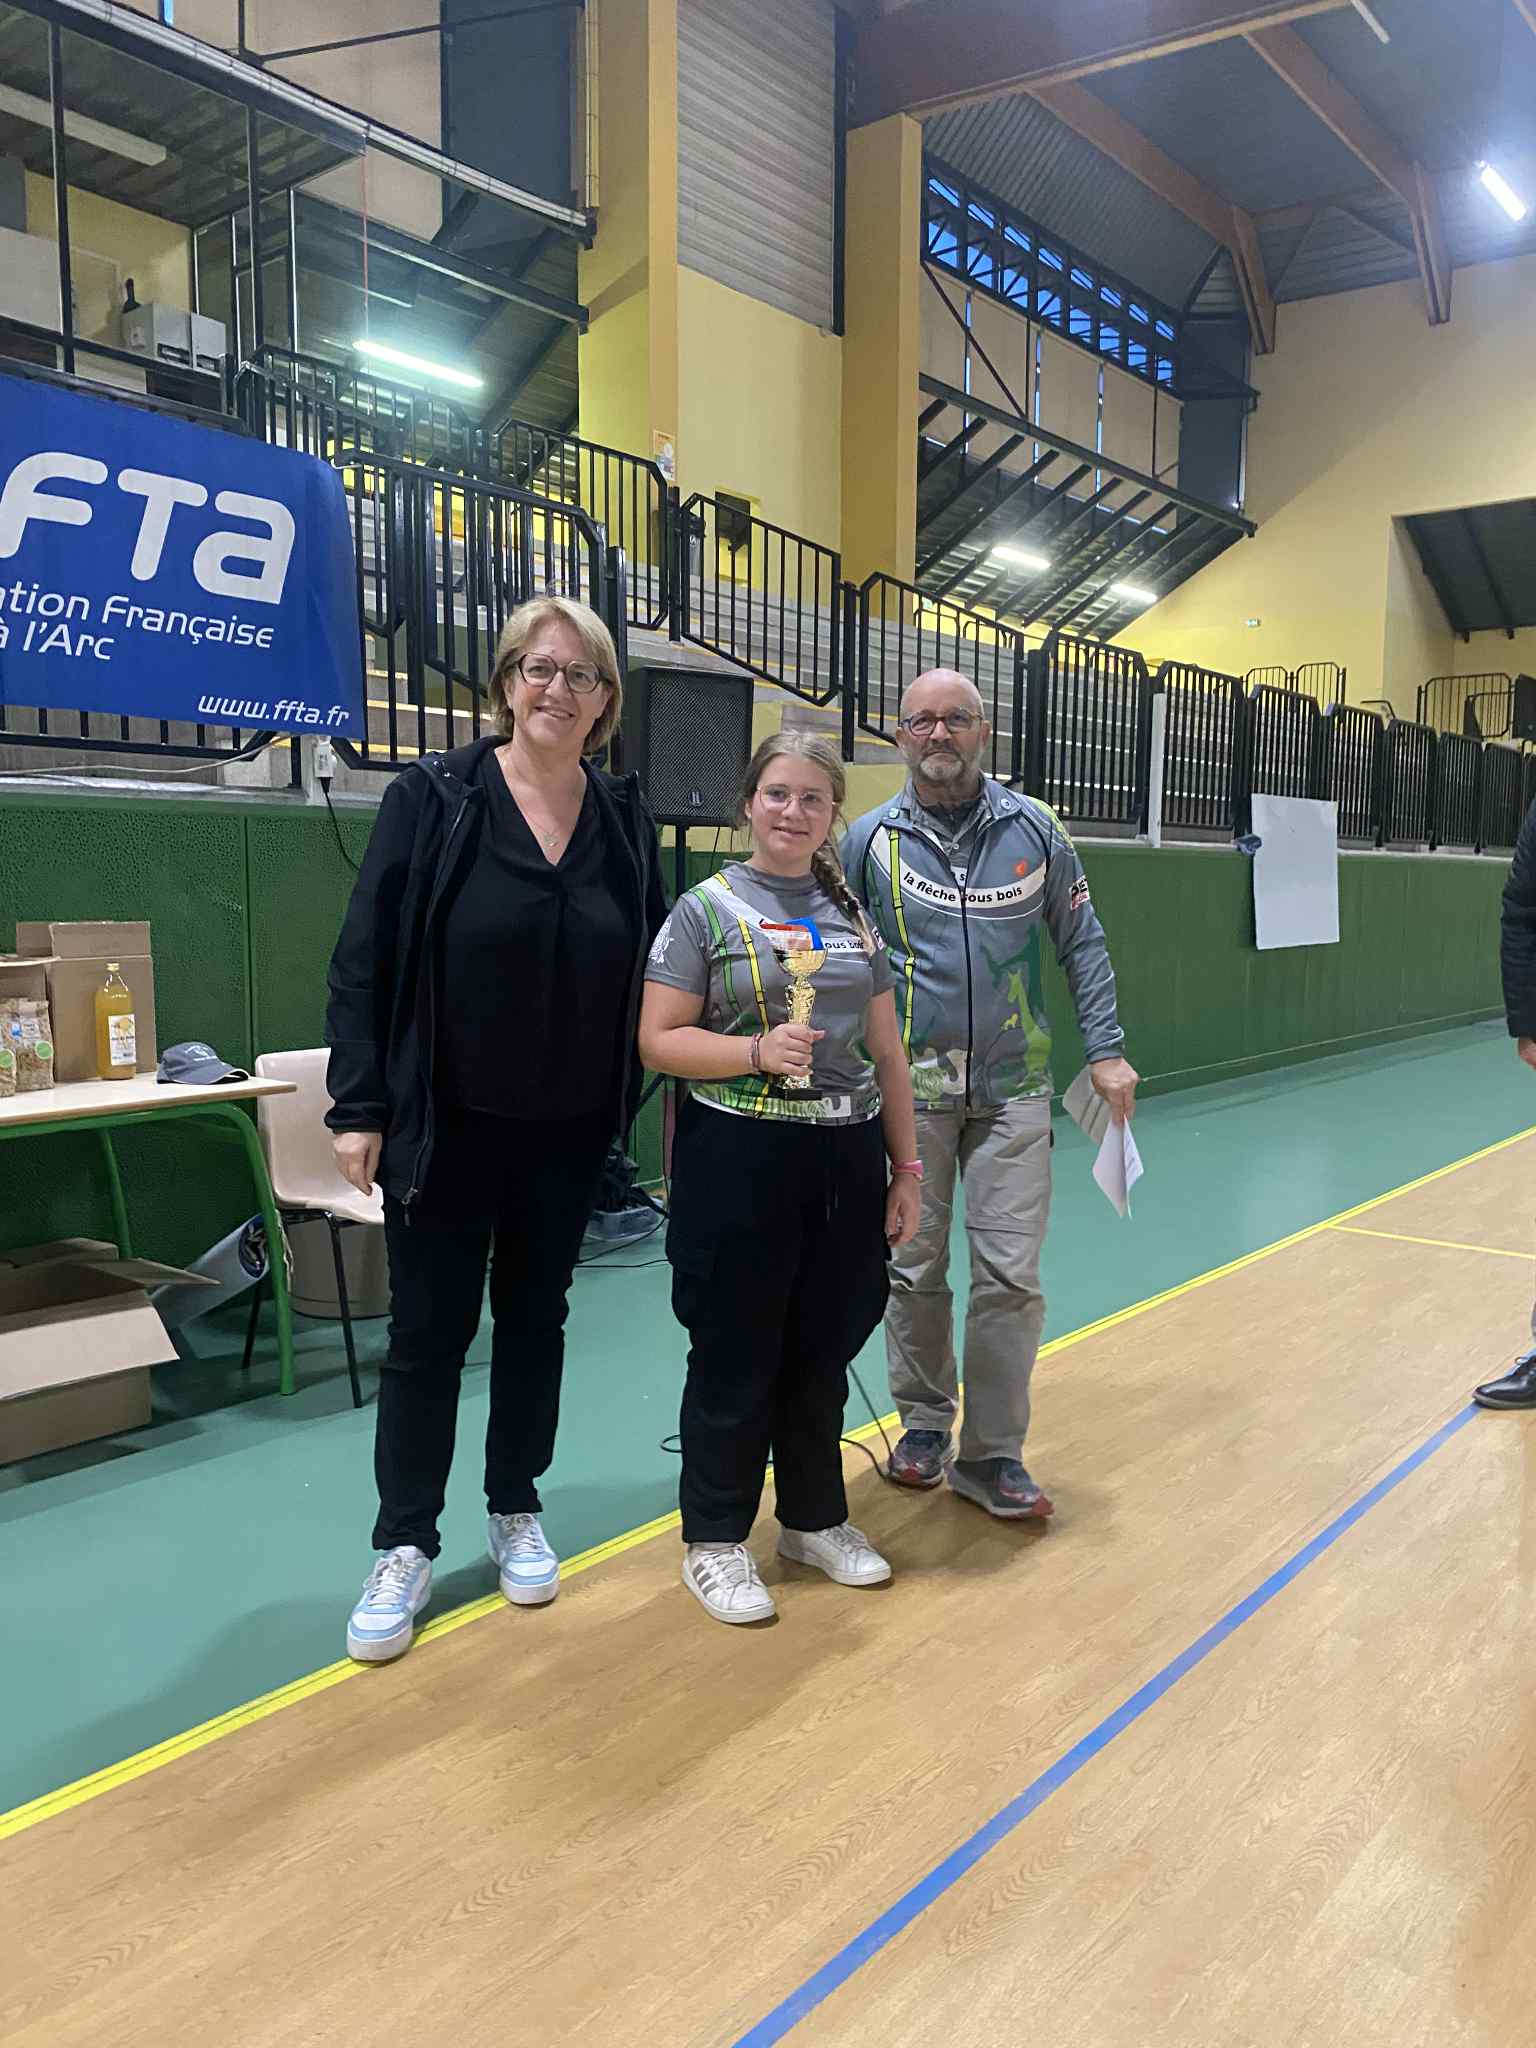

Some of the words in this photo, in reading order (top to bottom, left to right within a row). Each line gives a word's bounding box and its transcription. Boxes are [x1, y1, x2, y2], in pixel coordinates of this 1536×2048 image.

[101, 595, 275, 648] Française
[23, 620, 115, 660] l'Arc
[197, 695, 350, 727] www.ffta.fr
[903, 871, 915, 887] la
[916, 880, 957, 902] flèche
[996, 886, 1023, 902] bois
